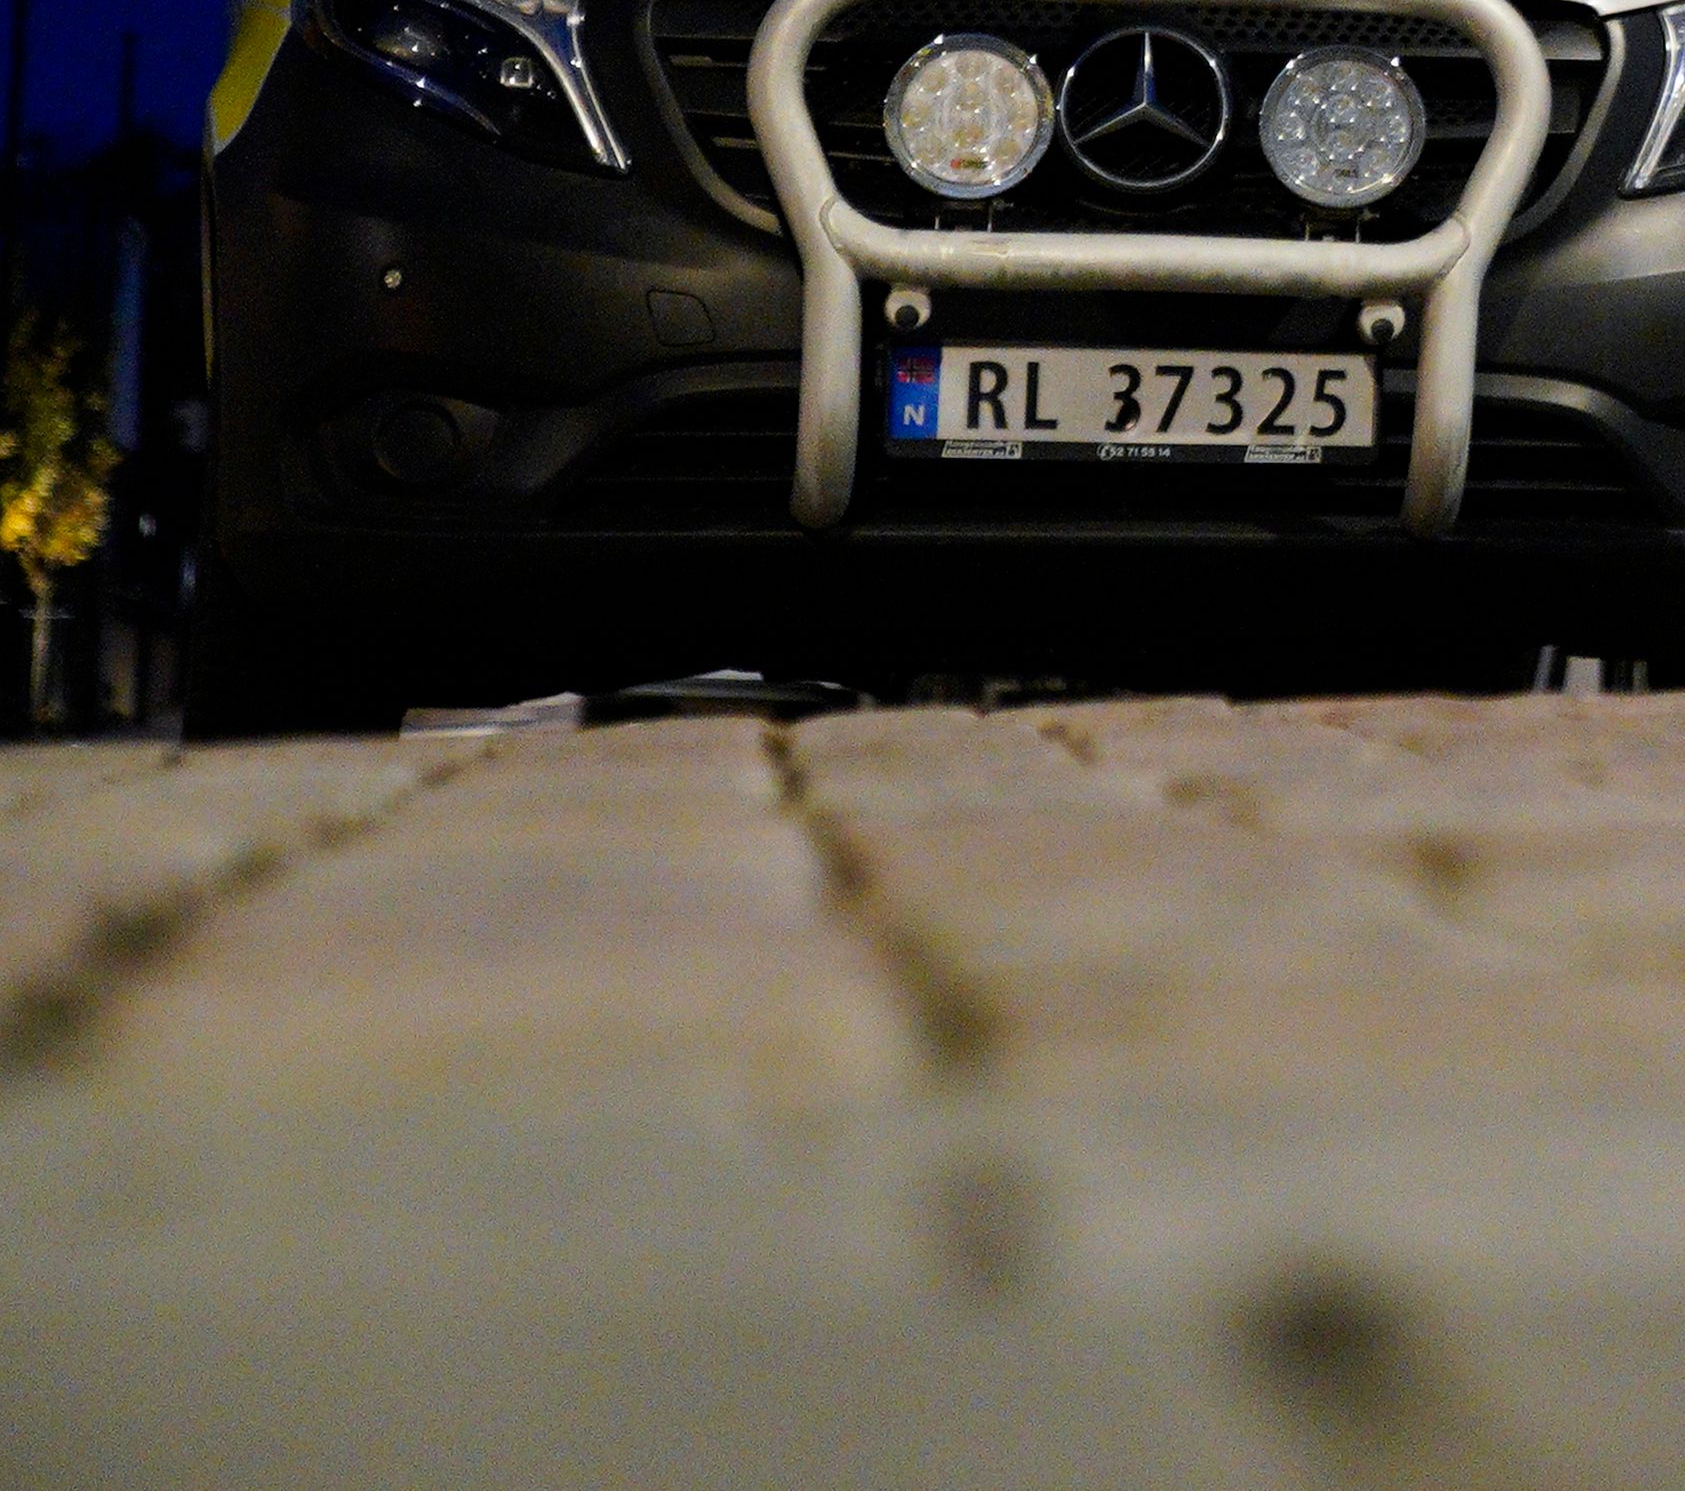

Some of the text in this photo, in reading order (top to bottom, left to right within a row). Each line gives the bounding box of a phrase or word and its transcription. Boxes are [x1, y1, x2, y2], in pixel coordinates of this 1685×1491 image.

[903, 406, 926, 427] N
[966, 360, 1348, 437] RL 37325
